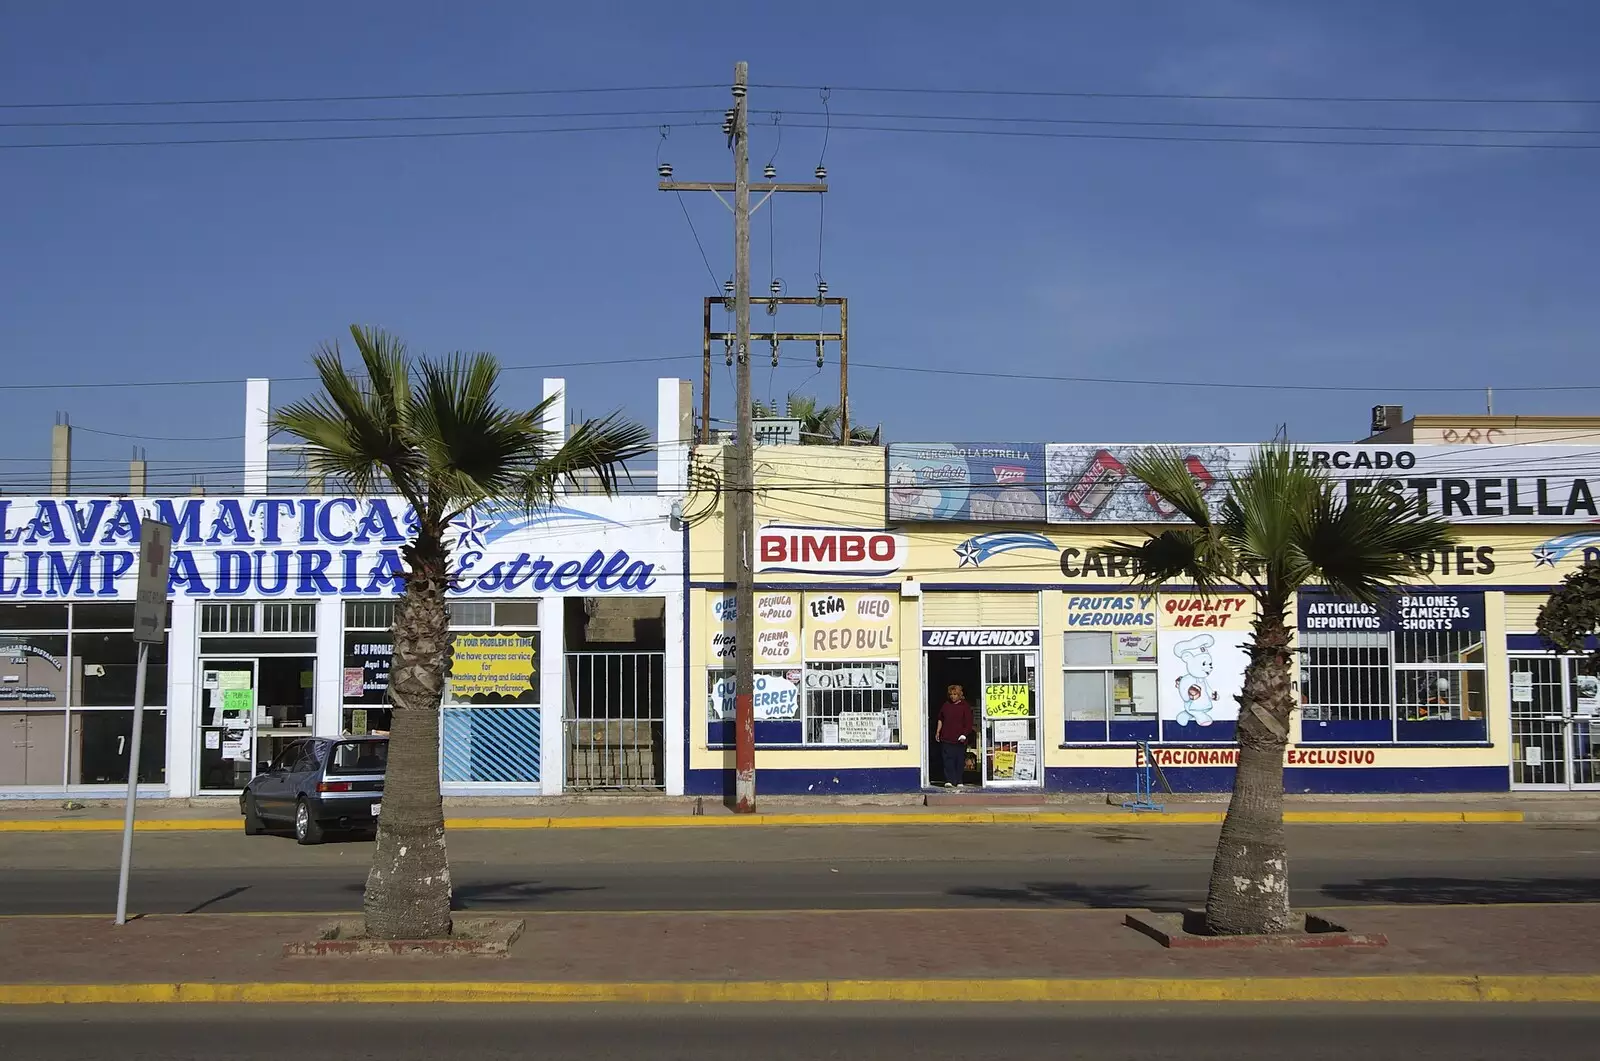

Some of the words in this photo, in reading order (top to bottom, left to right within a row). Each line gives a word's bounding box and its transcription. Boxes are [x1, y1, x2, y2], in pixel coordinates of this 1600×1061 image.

[967, 449, 981, 458] LA
[983, 449, 1030, 460] ESTRELLA
[0, 498, 406, 546] LAVAMATICA
[760, 535, 896, 562] BIMBO
[0, 550, 408, 597] LIMPADURIA
[449, 549, 657, 594] Estrella
[758, 596, 792, 608] PECHUGA
[810, 595, 846, 617] LEÑA
[857, 599, 890, 618] HIELO
[1067, 597, 1136, 610] FRUTAS
[1138, 596, 1152, 610] Y
[1165, 598, 1247, 612] QUALITY
[1308, 602, 1378, 615] ARTICULOS
[1402, 596, 1459, 608] BALONES
[767, 609, 792, 619] POLLO
[1068, 612, 1155, 626] VERDURAS
[1402, 607, 1470, 619] CAMISETAS
[1174, 614, 1231, 627] MEAT
[1306, 616, 1381, 629] DEPORTIVOS
[1402, 618, 1453, 630] SHORTS
[463, 638, 478, 647] YOUR
[480, 638, 507, 647] PROBLEM
[507, 638, 514, 647] IS
[515, 638, 532, 647] TIME
[813, 628, 853, 651] RED
[856, 625, 894, 650] BULL
[927, 630, 1035, 646] BIENVENIDOS
[353, 644, 361, 655] SI
[361, 644, 369, 655] SU
[717, 647, 727, 657] de
[761, 647, 790, 656] POLLO
[33, 646, 62, 670] DISTANCIA
[455, 652, 465, 660] We
[467, 652, 482, 660] have
[483, 653, 507, 662] express
[508, 652, 531, 660] service
[481, 662, 492, 670] for
[805, 670, 885, 688] COPIAS
[717, 677, 767, 698] QUO
[985, 685, 1026, 695] CESINA
[721, 689, 797, 711] MERREY
[765, 703, 795, 715] JACK
[986, 700, 1029, 717] GUERRERO
[1136, 750, 1240, 766] ETACIONAMI
[1287, 750, 1375, 766] EXCLUSIVO
